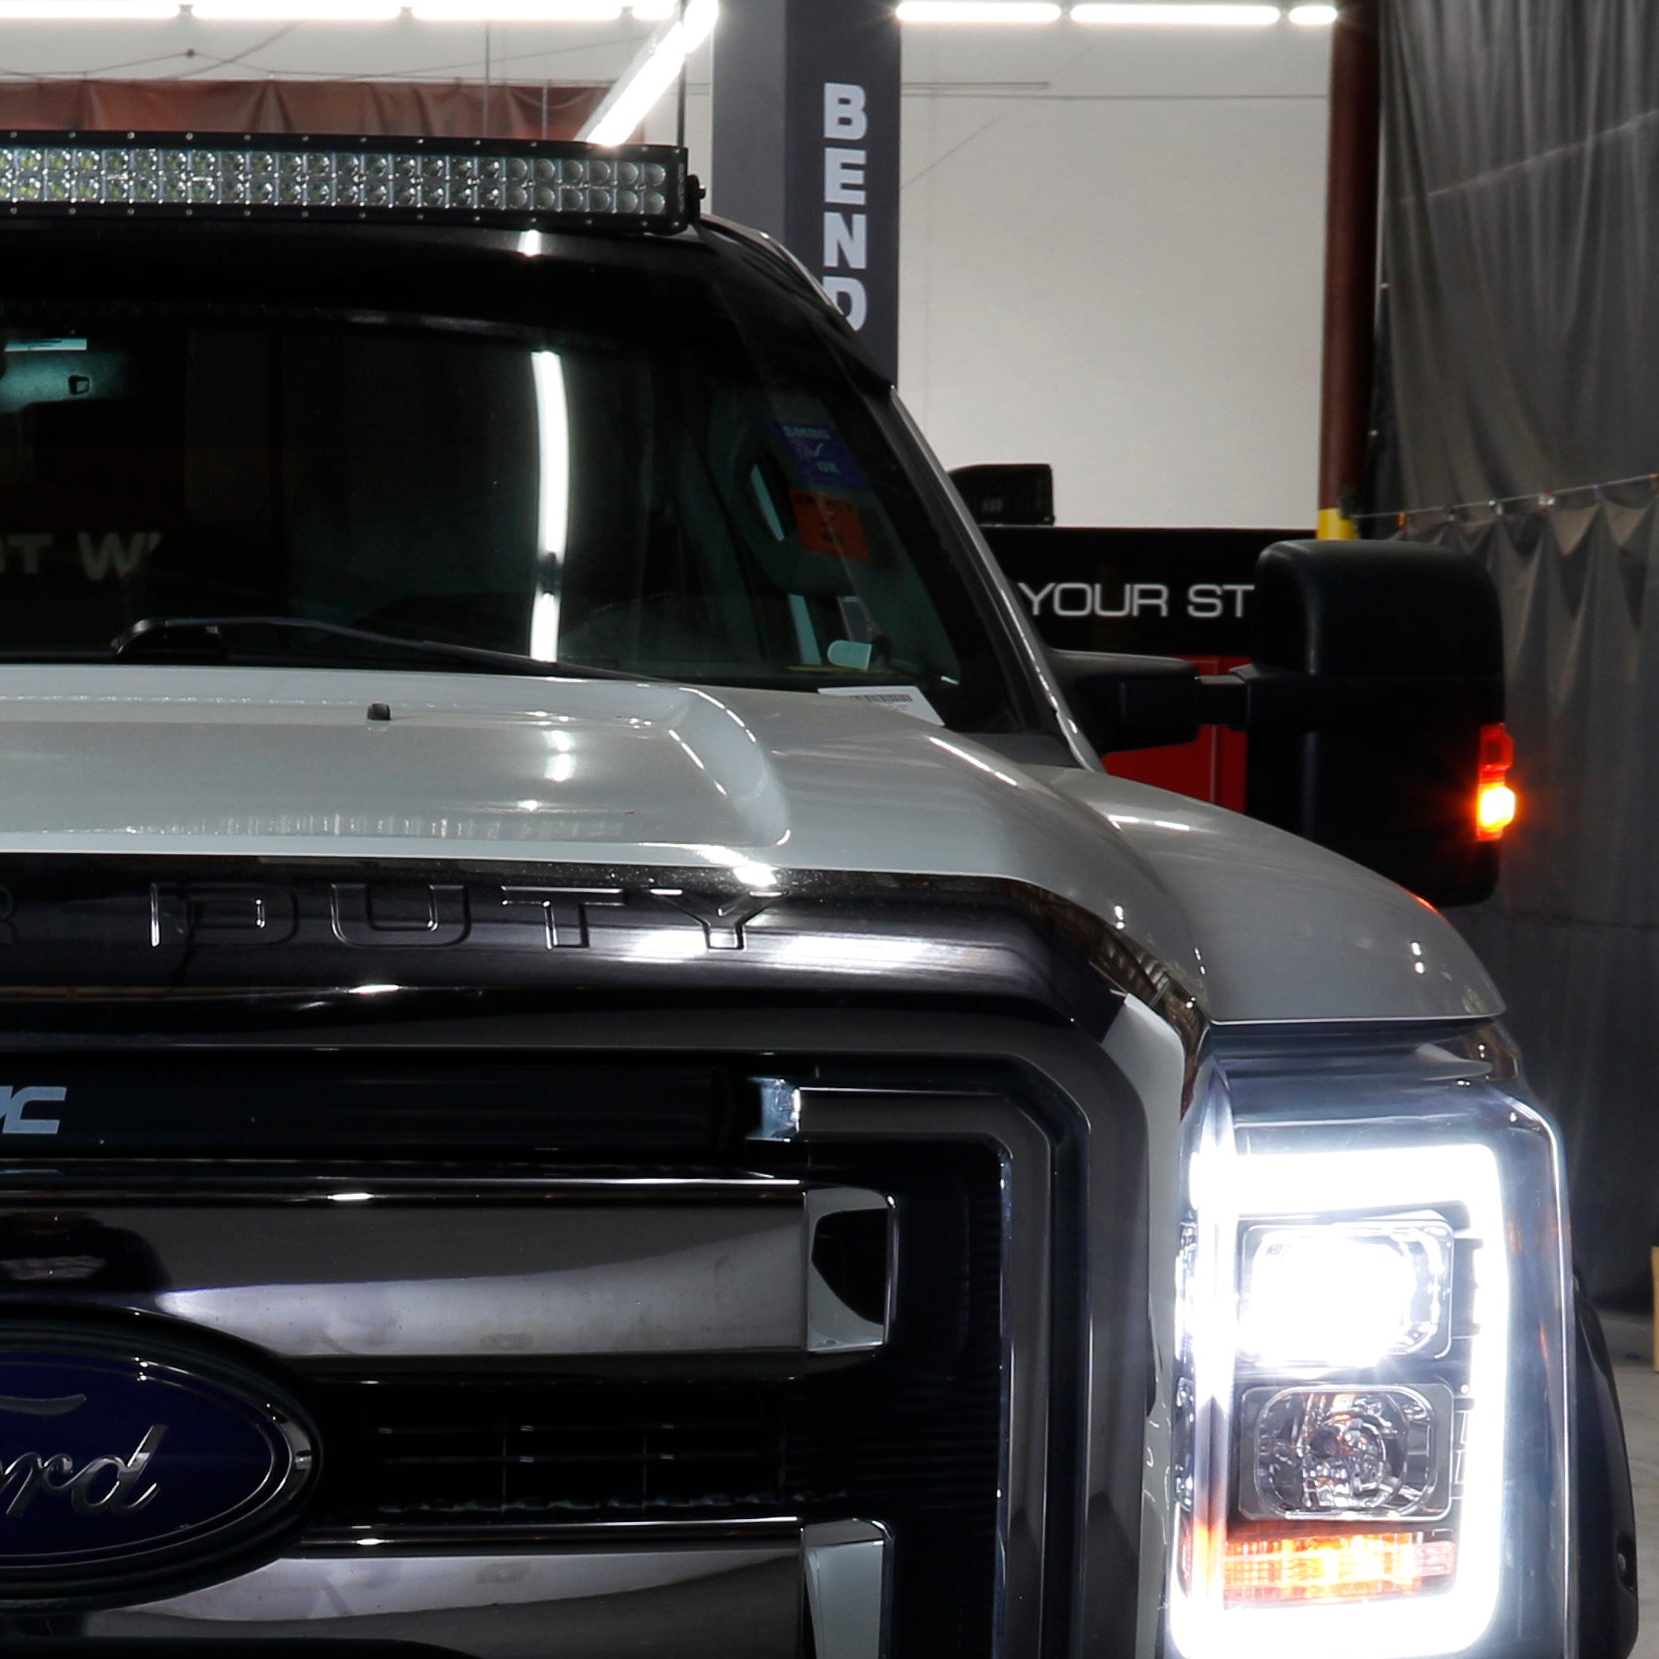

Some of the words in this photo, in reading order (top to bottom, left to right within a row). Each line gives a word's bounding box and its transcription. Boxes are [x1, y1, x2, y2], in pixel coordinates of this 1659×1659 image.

[823, 82, 868, 332] BEND
[1017, 582, 1169, 617] YOUR
[1187, 583, 1256, 618] ST
[149, 880, 791, 950] DUTY
